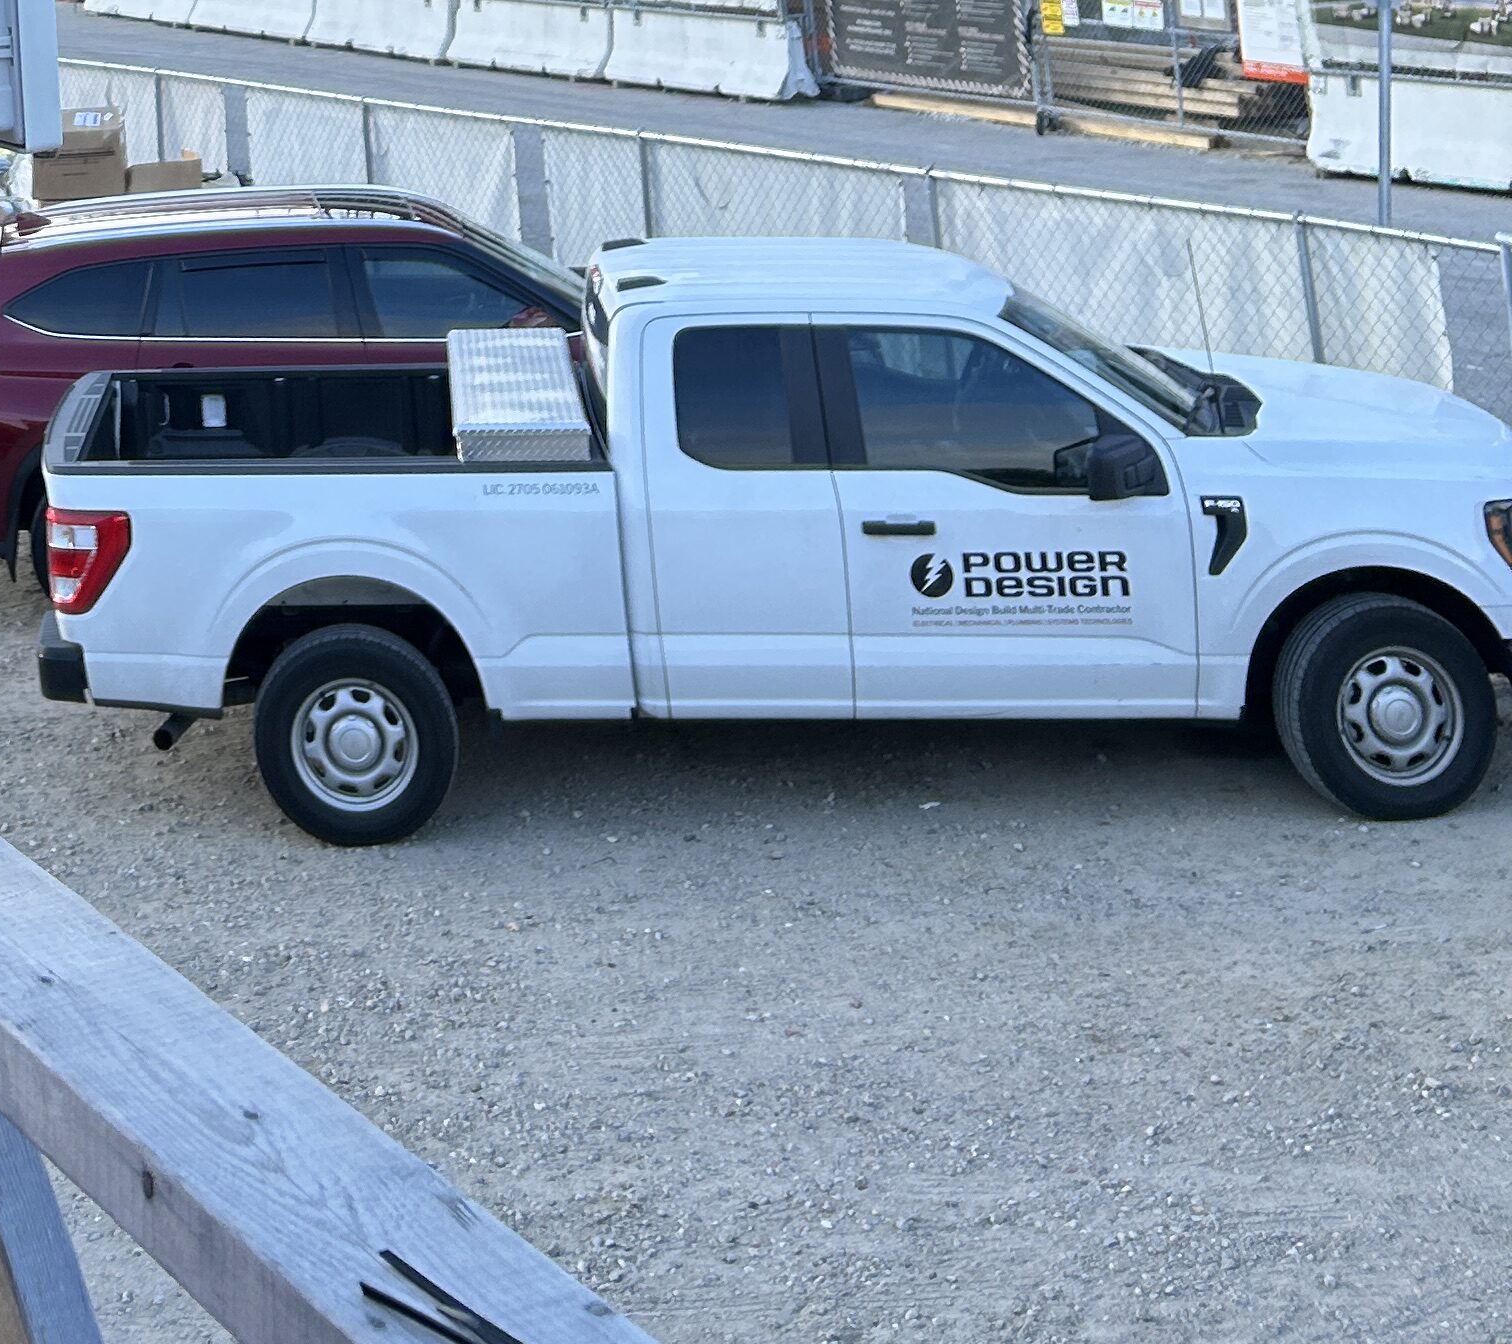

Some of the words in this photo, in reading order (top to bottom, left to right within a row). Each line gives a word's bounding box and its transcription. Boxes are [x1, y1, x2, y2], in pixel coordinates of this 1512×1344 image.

[912, 606, 953, 616] National
[955, 605, 990, 617] Design
[992, 604, 1018, 615] Build
[1019, 604, 1076, 615] Multi-Trade
[1077, 604, 1132, 615] Contractor
